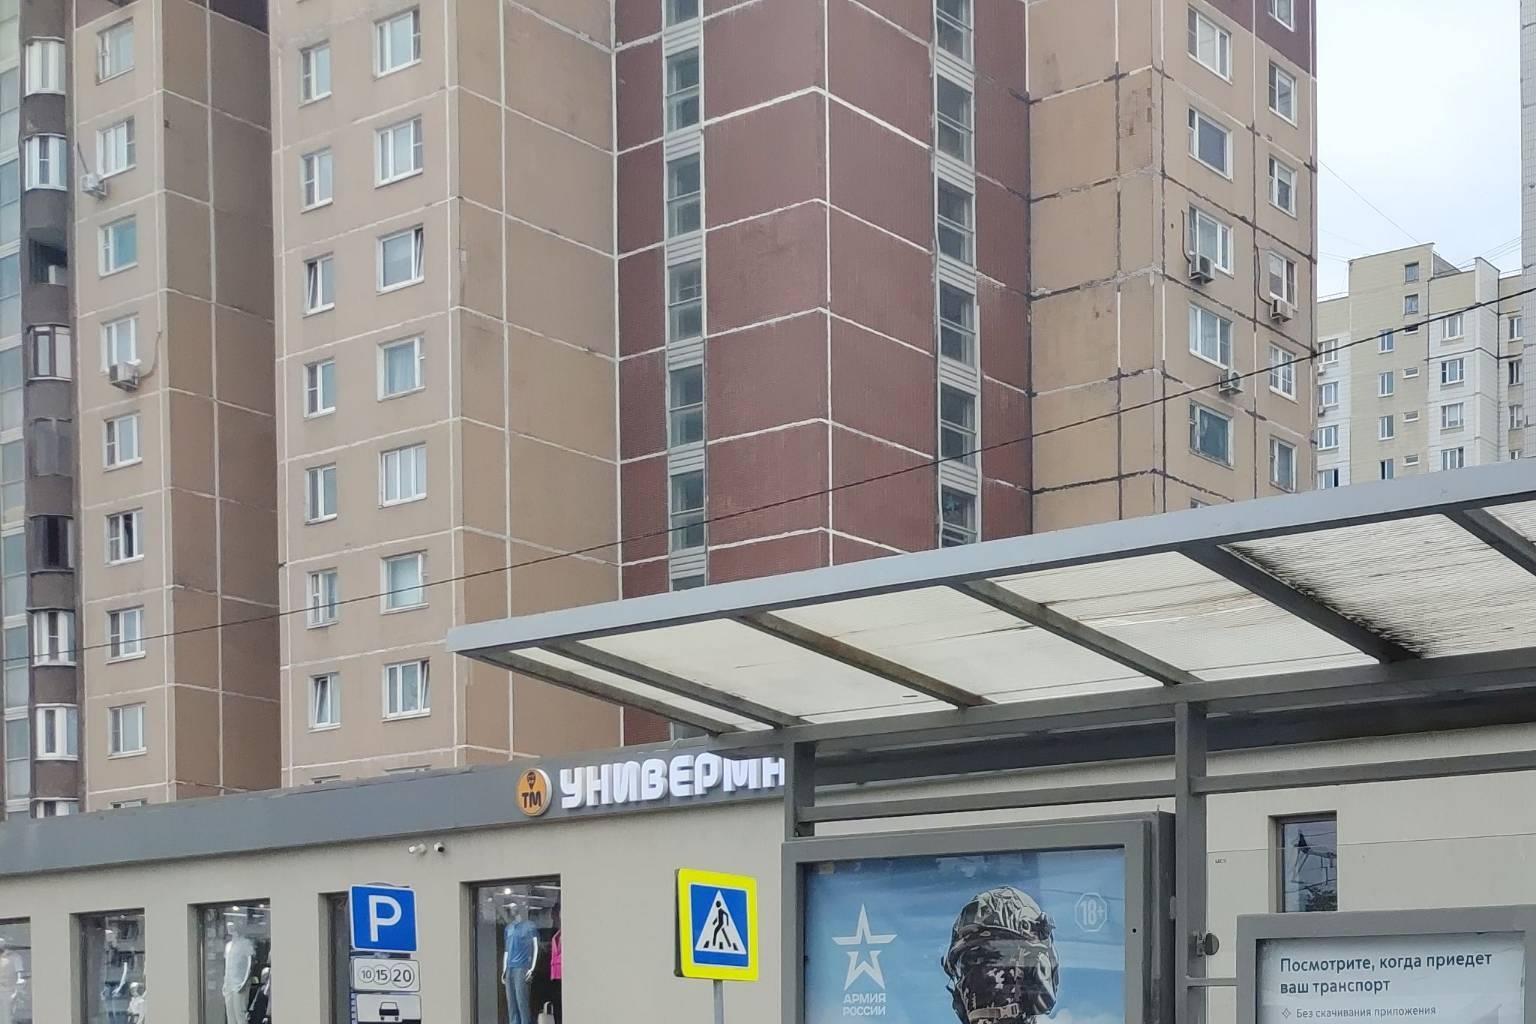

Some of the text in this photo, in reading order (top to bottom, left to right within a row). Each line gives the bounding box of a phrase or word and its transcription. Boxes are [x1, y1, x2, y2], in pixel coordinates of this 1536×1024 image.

[368, 894, 402, 942] P
[1079, 899, 1106, 925] 18+
[1280, 952, 1492, 975] Посмотрите, когда приедет
[361, 968, 412, 982] 10 15 20
[1280, 978, 1390, 996] ваш транспорт
[843, 993, 886, 1005] АРМИЯ
[842, 1005, 887, 1017] РОССИИ
[1296, 1005, 1436, 1018] Без скачивания приложения
